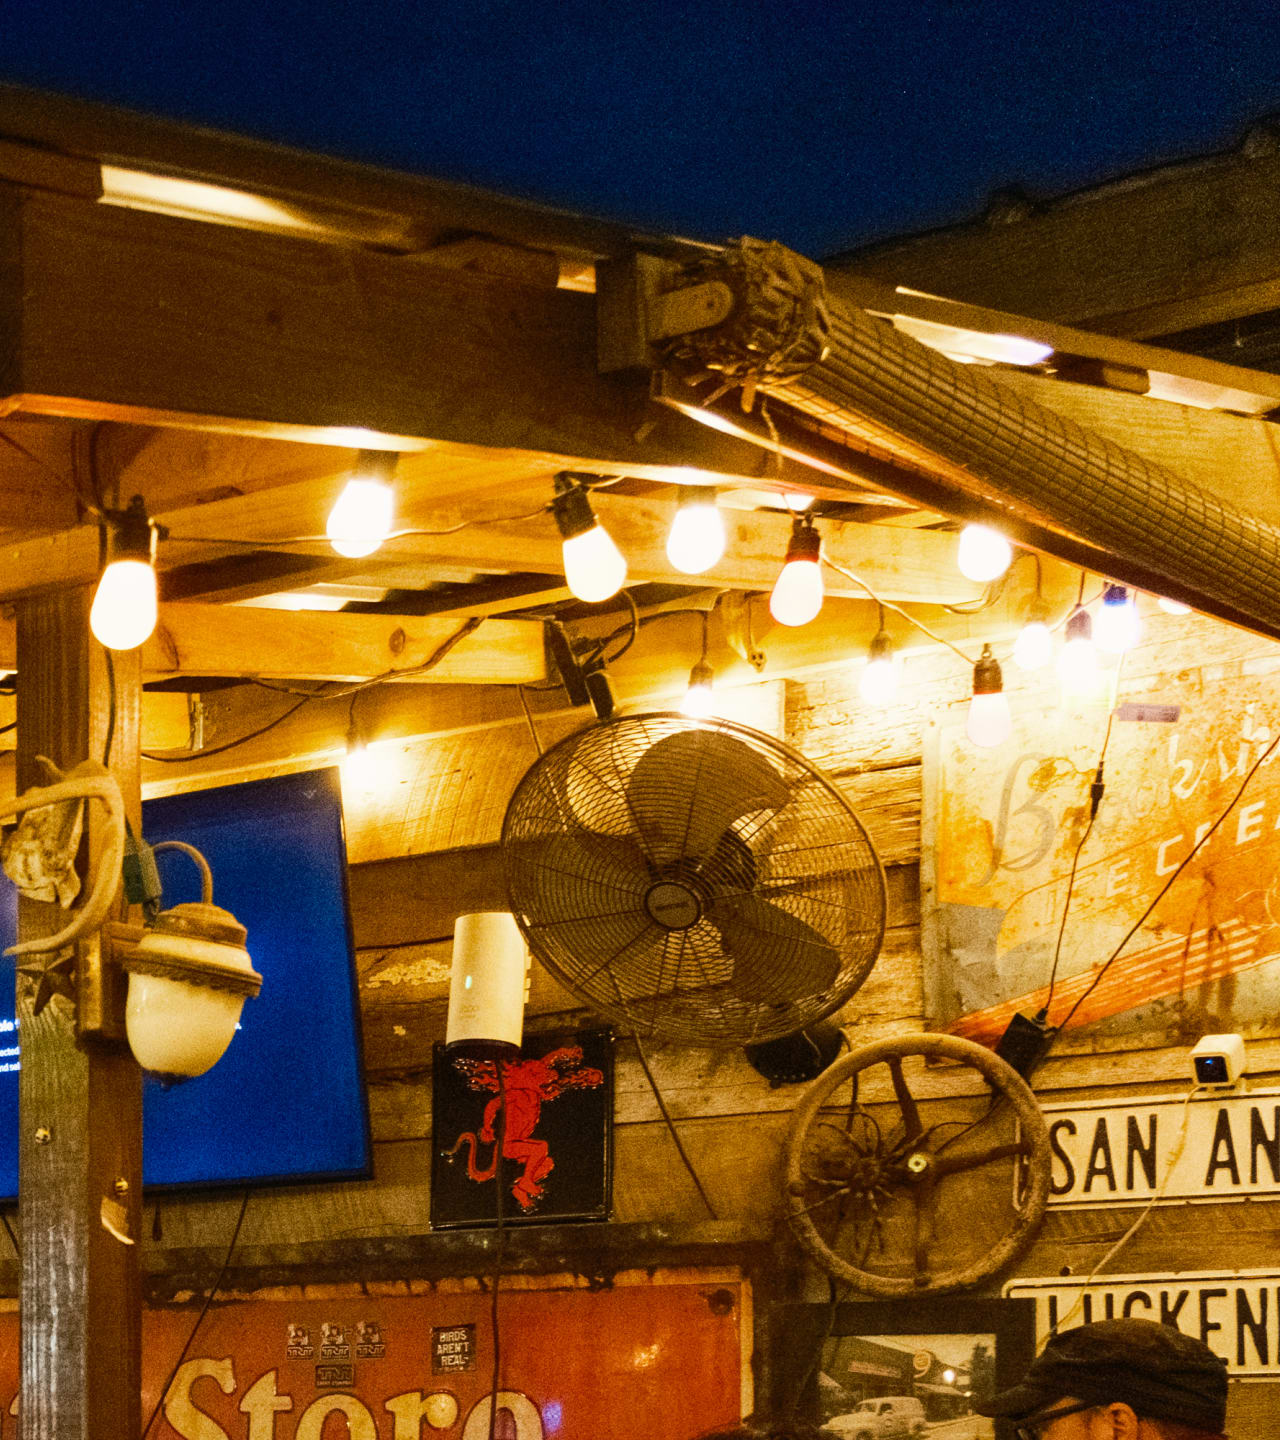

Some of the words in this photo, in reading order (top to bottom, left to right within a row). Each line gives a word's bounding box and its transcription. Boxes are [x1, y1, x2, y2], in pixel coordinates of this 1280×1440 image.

[1049, 1113, 1158, 1196] SAN
[1204, 1104, 1280, 1187] AN
[439, 1329, 468, 1343] BIRDS
[436, 1341, 470, 1355] AREN'T
